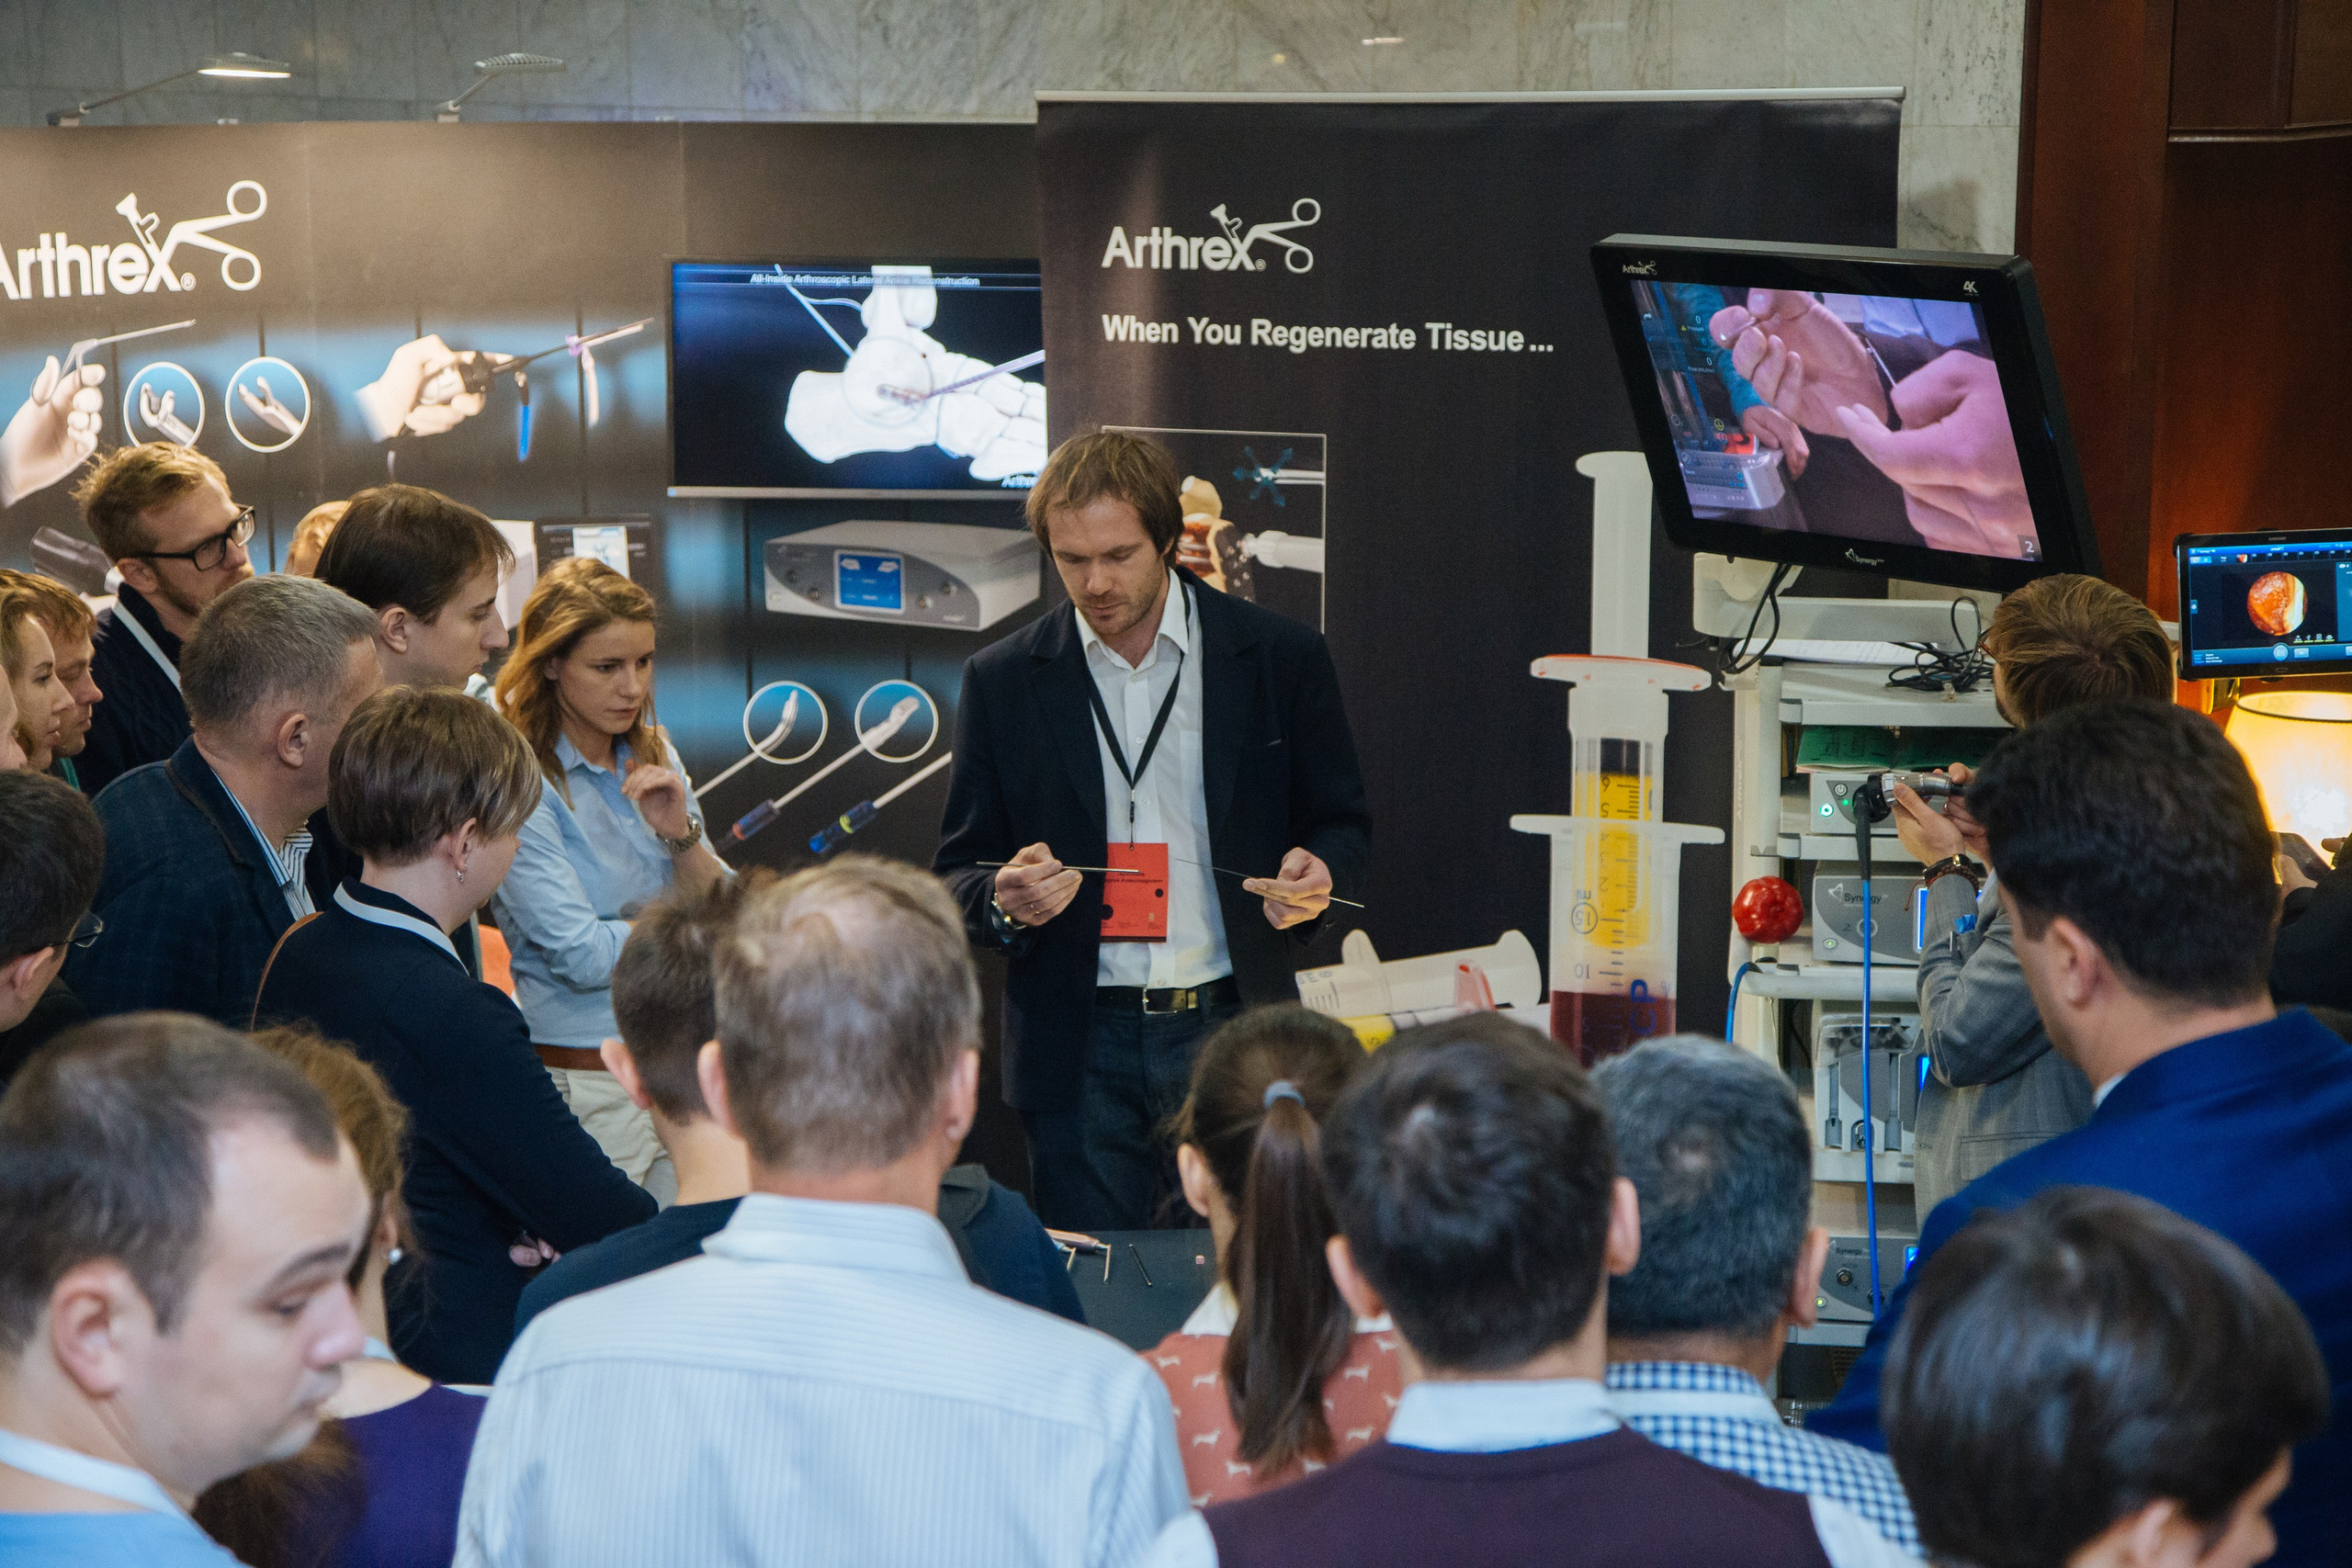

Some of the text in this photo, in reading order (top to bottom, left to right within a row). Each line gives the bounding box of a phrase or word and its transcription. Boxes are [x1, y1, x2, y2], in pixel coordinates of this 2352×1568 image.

[1963, 280, 1978, 293] 4K
[1102, 314, 1180, 344] When
[1187, 316, 1242, 345] You
[1250, 318, 1417, 355] Regenerate
[2024, 540, 2035, 553] 2
[1844, 892, 1882, 905] Syngy
